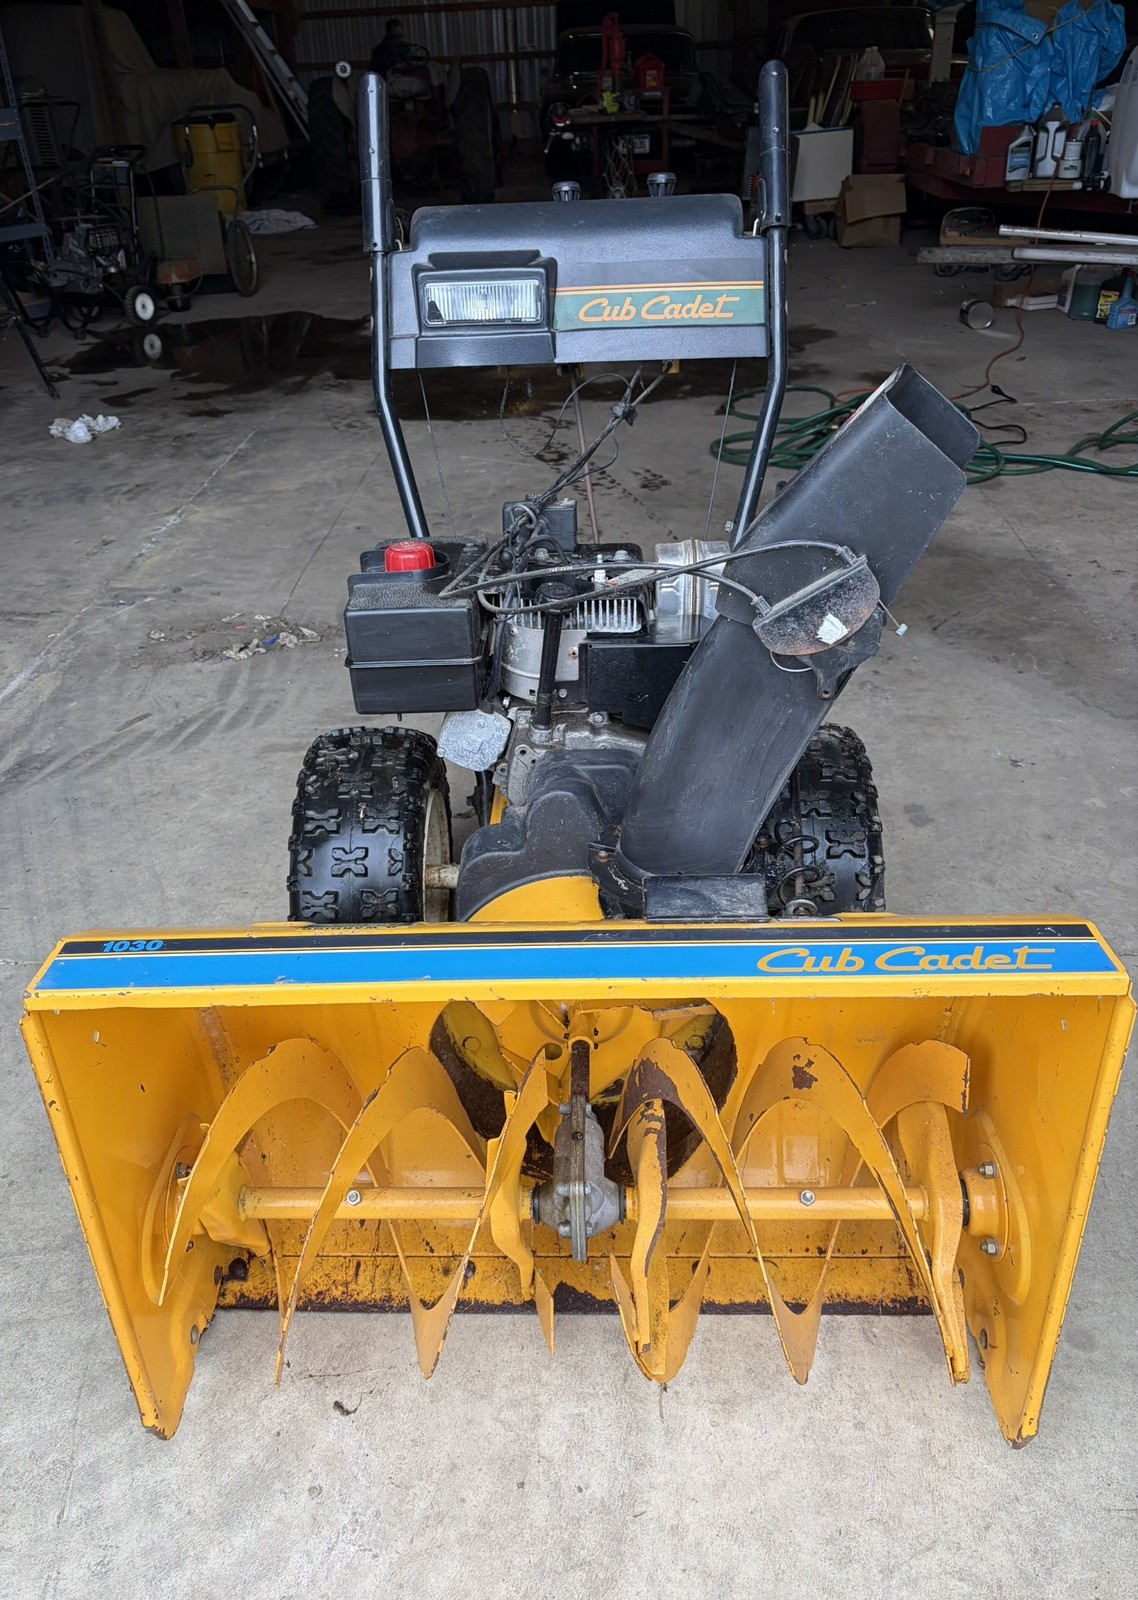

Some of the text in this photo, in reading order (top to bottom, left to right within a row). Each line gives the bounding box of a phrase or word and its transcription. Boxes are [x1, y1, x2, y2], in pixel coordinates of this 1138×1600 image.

[578, 294, 740, 322] Cub Cadet
[103, 940, 164, 952] 1030
[757, 945, 1056, 973] Cub Cadet
